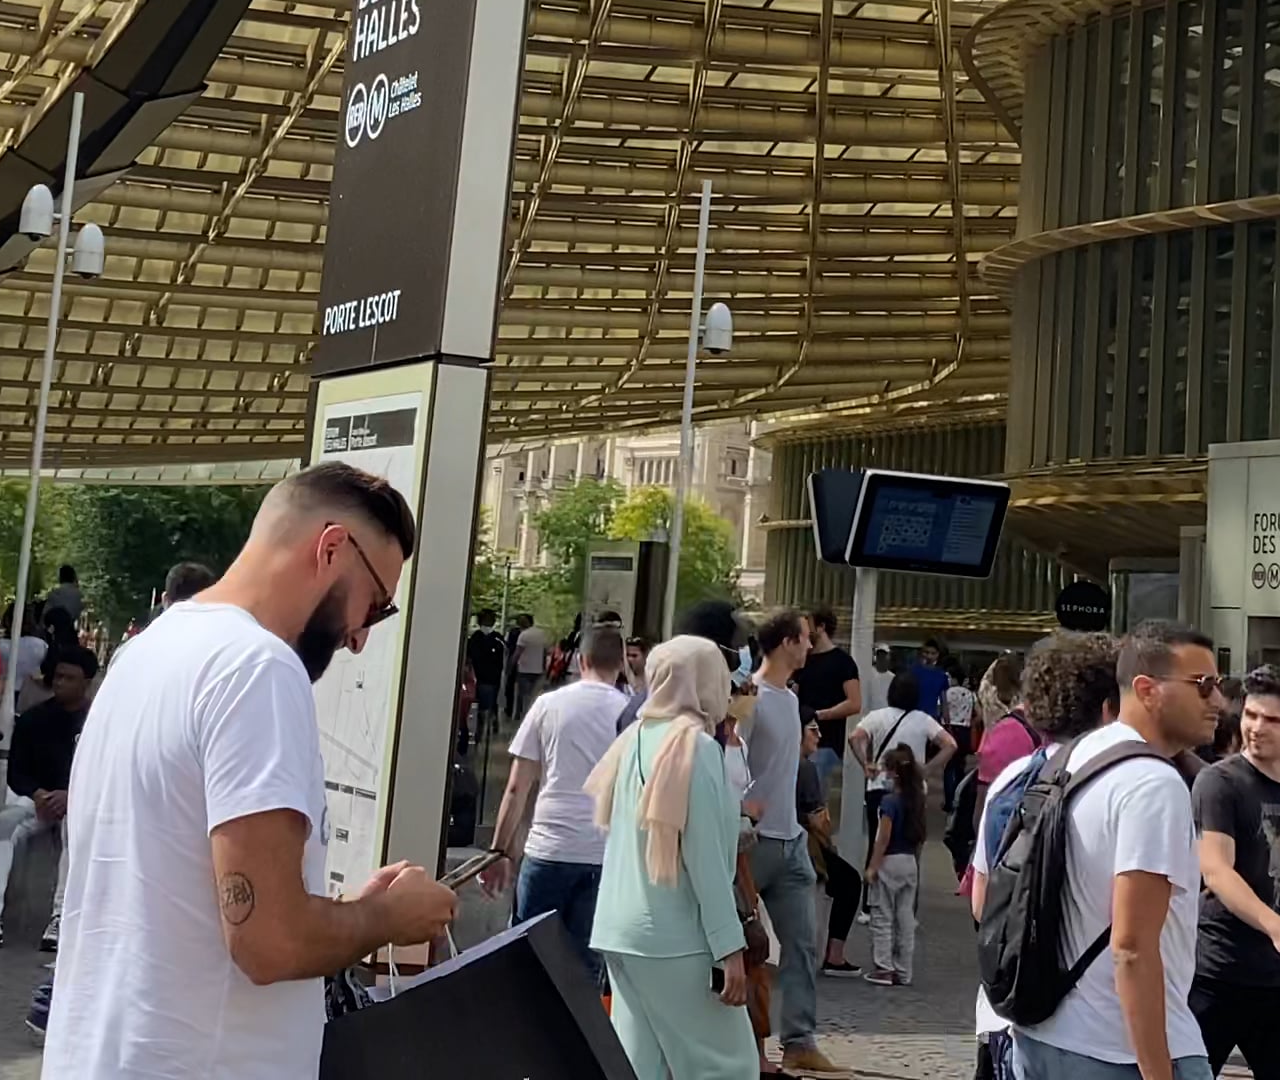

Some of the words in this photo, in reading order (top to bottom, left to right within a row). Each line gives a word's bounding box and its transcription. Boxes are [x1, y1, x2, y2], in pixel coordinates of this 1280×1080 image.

[323, 300, 358, 336] PORTE
[359, 290, 401, 328] LESCOT
[1253, 535, 1276, 554] DES
[1061, 604, 1105, 614] SEPHORA
